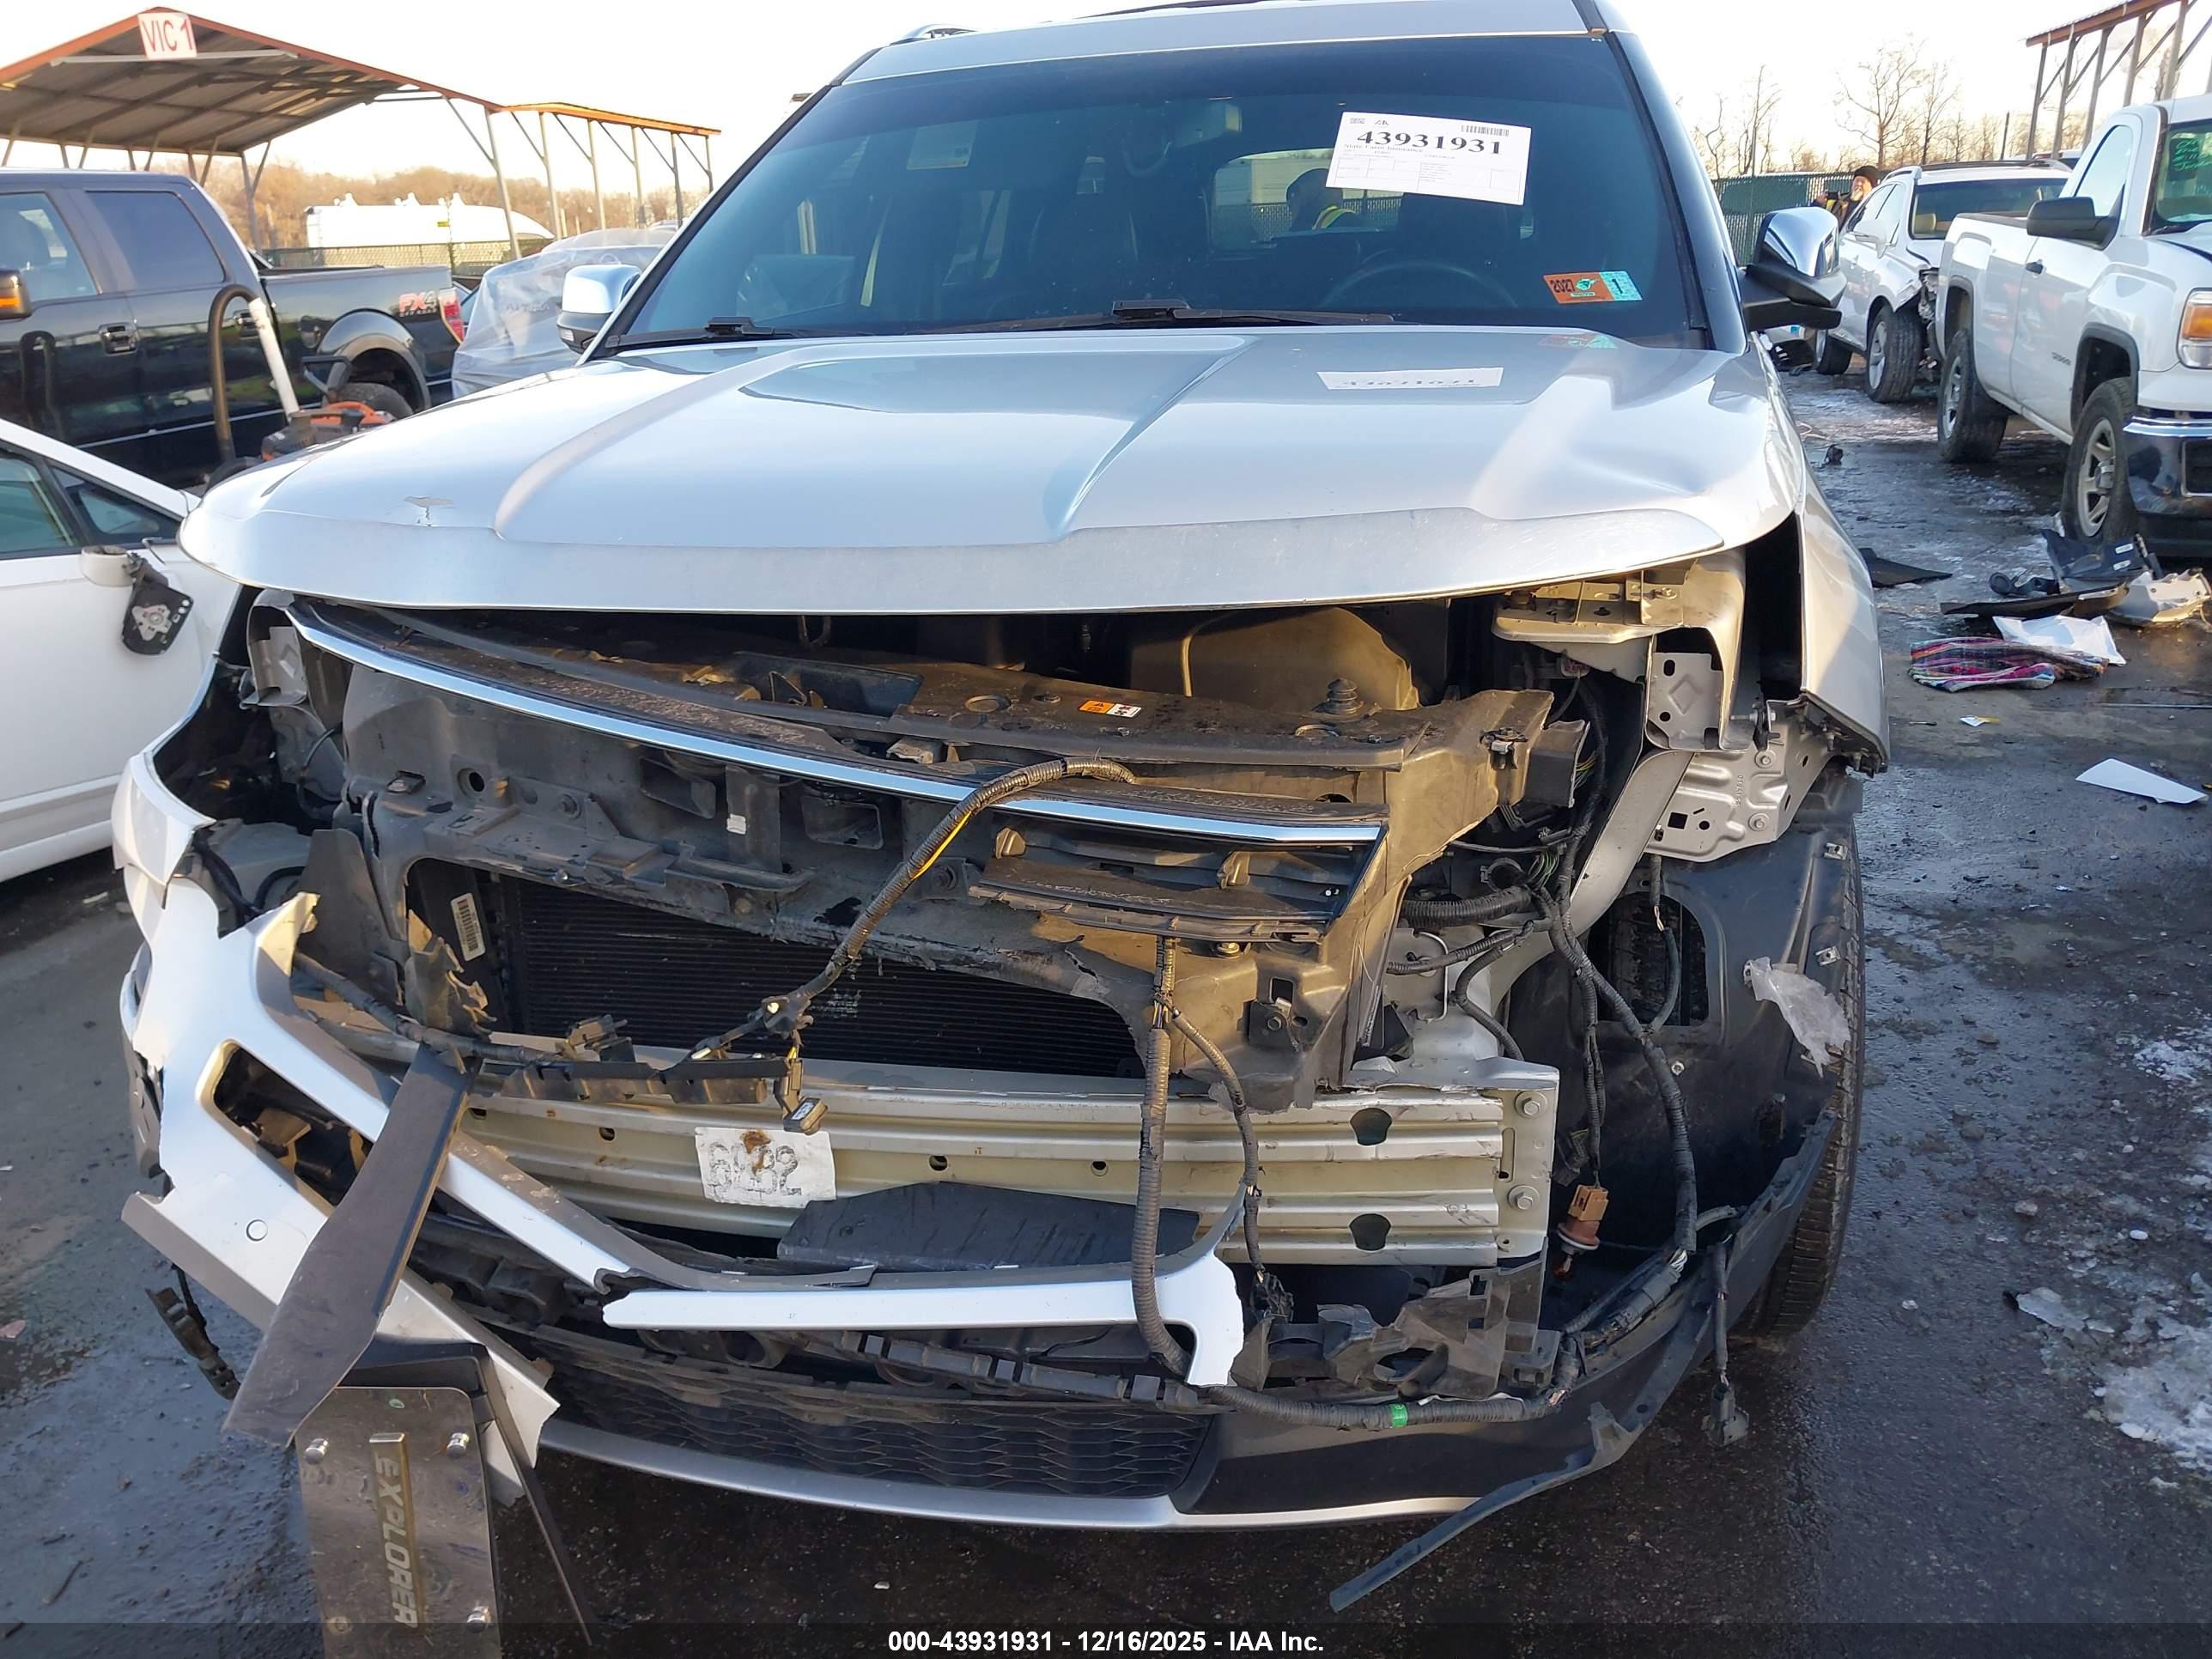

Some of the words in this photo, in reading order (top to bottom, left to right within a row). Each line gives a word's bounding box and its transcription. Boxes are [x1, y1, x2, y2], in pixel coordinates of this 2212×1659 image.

[142, 20, 177, 52] VIC
[180, 19, 192, 50] 1
[1357, 131, 1502, 155] 43931931
[1550, 278, 1576, 293] 2027
[1612, 278, 1624, 294] 1
[398, 290, 438, 313] FX4
[374, 1451, 418, 1629] EXPLORER
